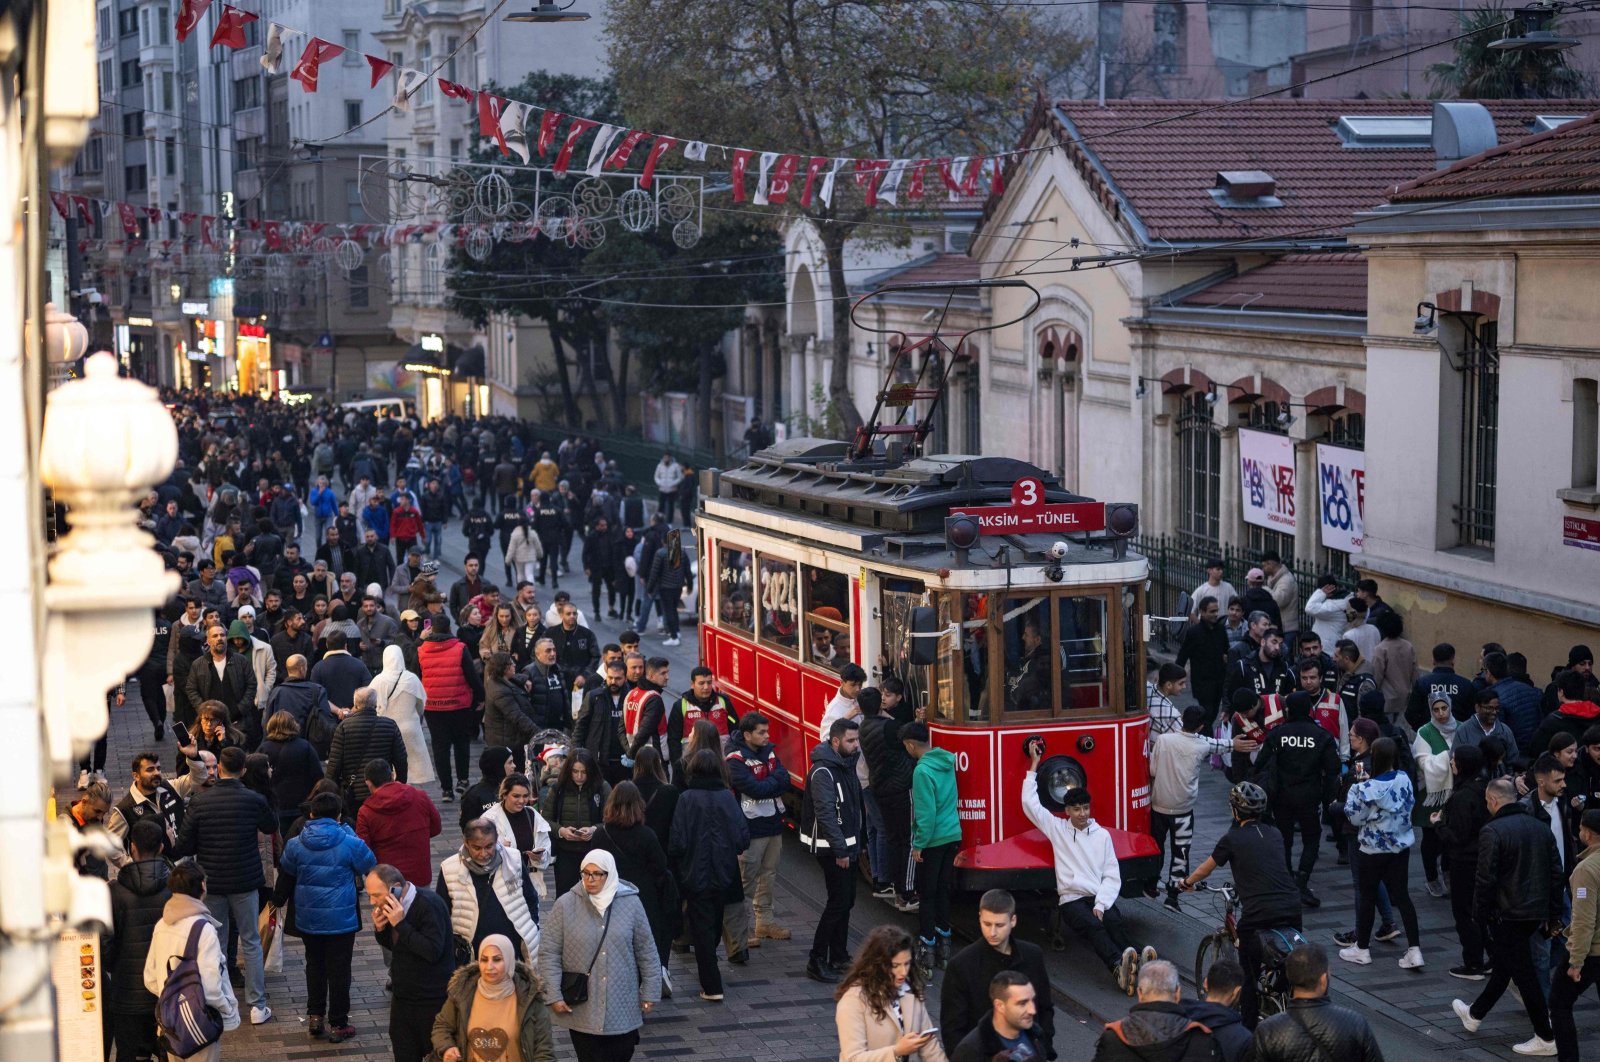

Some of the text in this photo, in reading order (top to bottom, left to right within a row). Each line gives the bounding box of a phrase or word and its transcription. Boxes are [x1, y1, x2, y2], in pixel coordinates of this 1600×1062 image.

[1020, 480, 1038, 506] 3
[978, 513, 1018, 527] AKSİM
[1036, 511, 1080, 525] TÜNEL
[965, 799, 986, 809] YASAK
[959, 809, 986, 820] İKELİDİR
